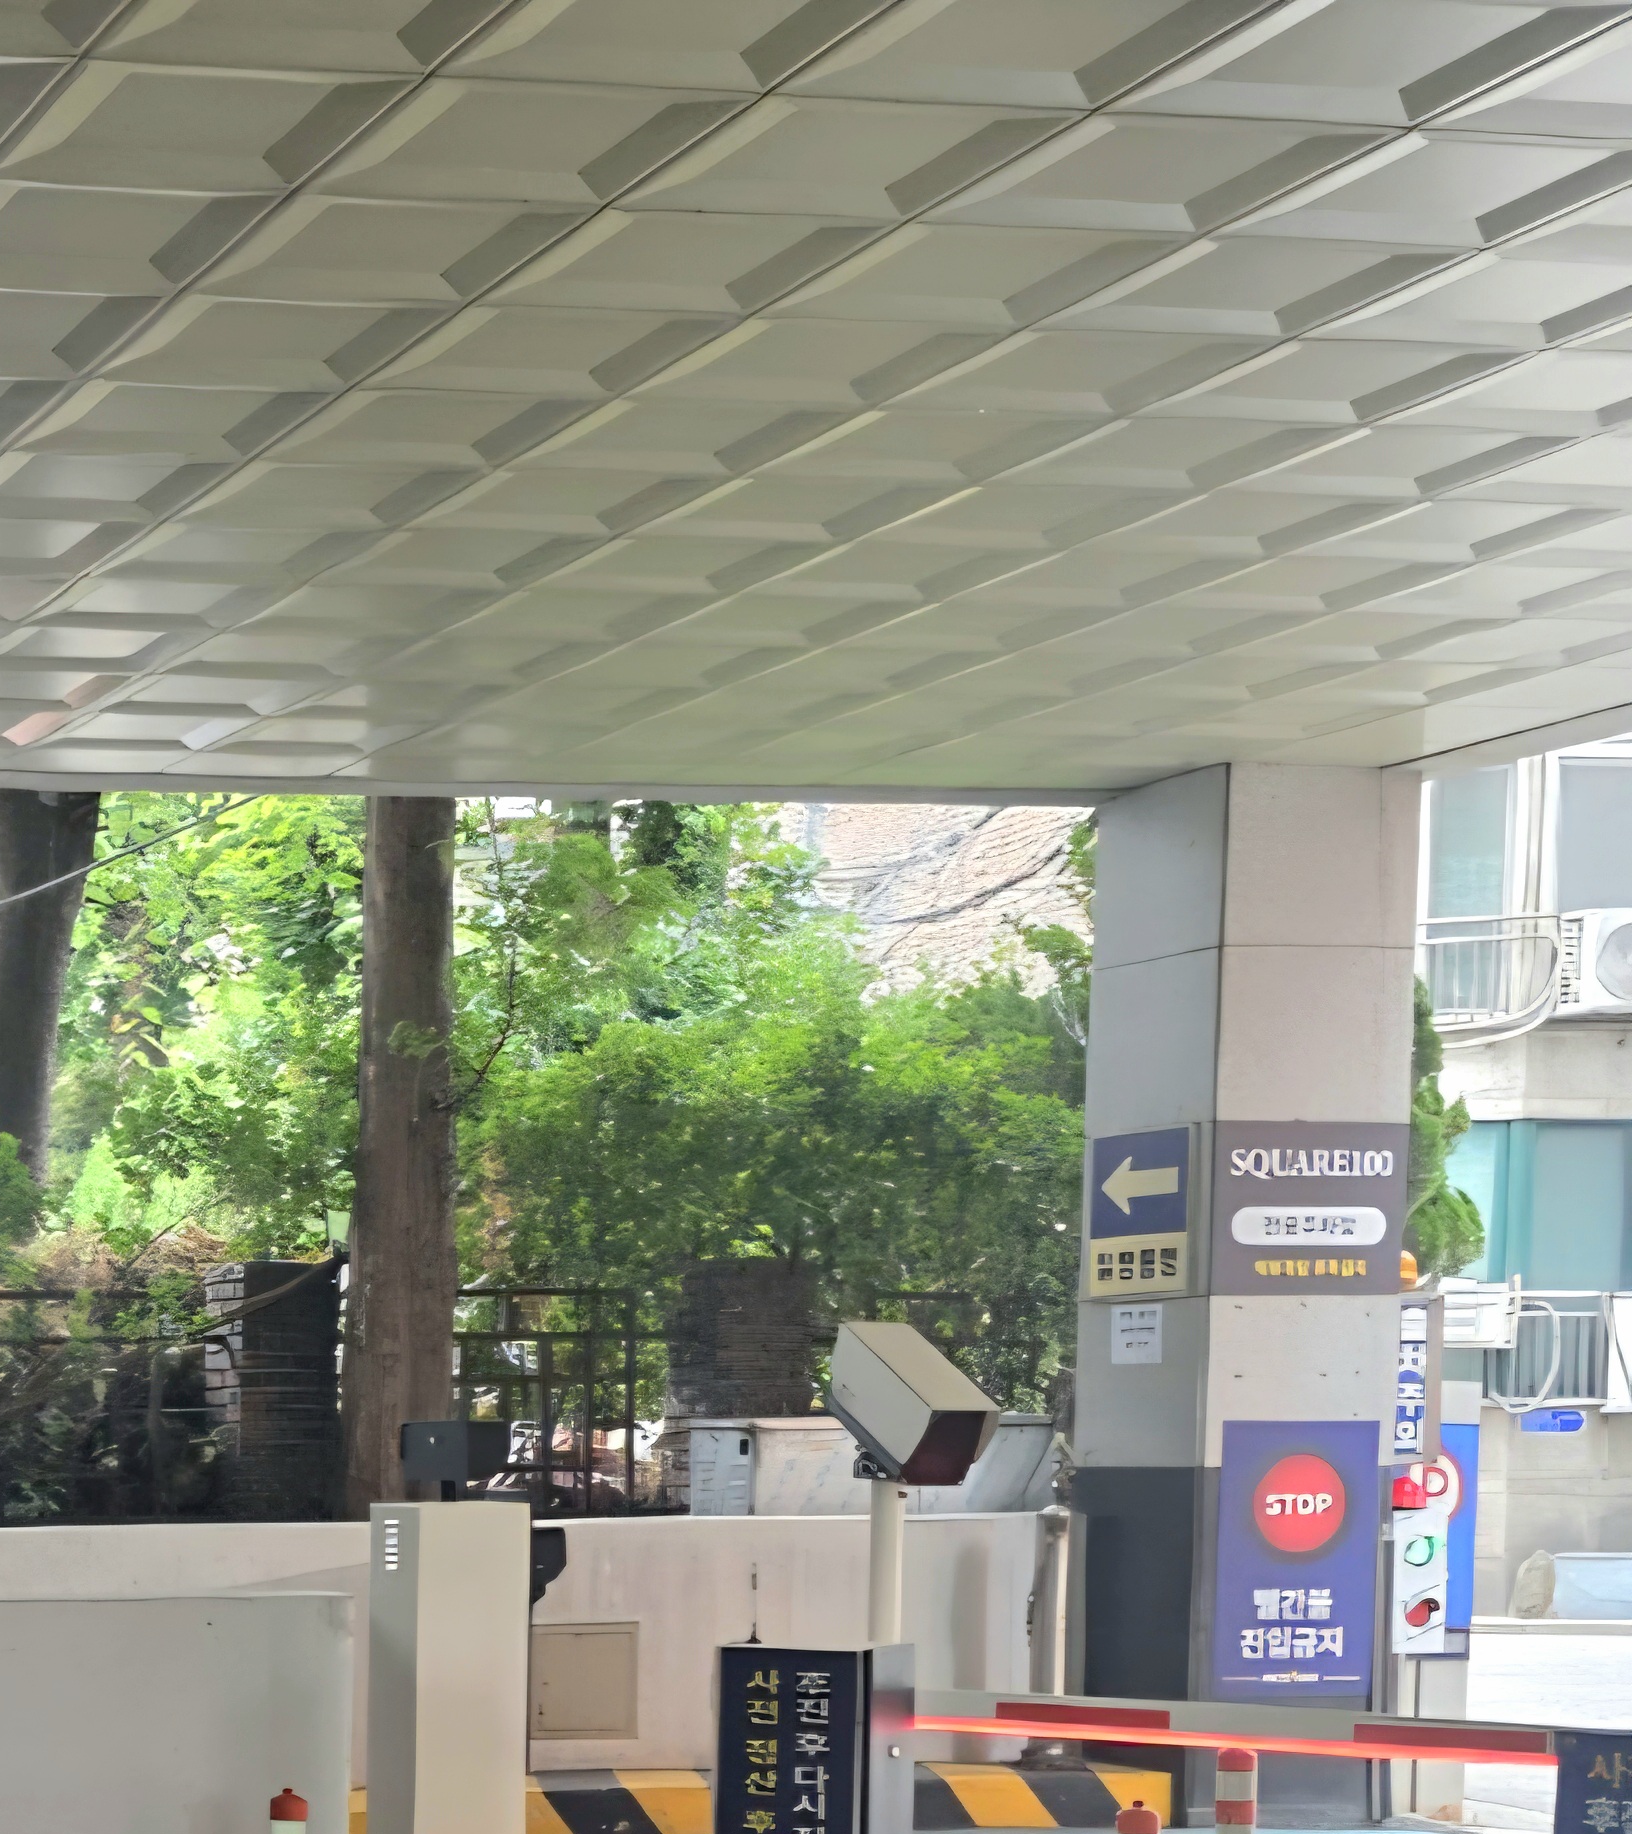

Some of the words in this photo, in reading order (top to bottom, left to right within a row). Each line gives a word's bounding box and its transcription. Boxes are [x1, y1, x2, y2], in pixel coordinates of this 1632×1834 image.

[1230, 1148, 1394, 1180] SQUARE100
[1265, 1492, 1333, 1516] STOP
[1240, 1626, 1344, 1660] 진입금지
